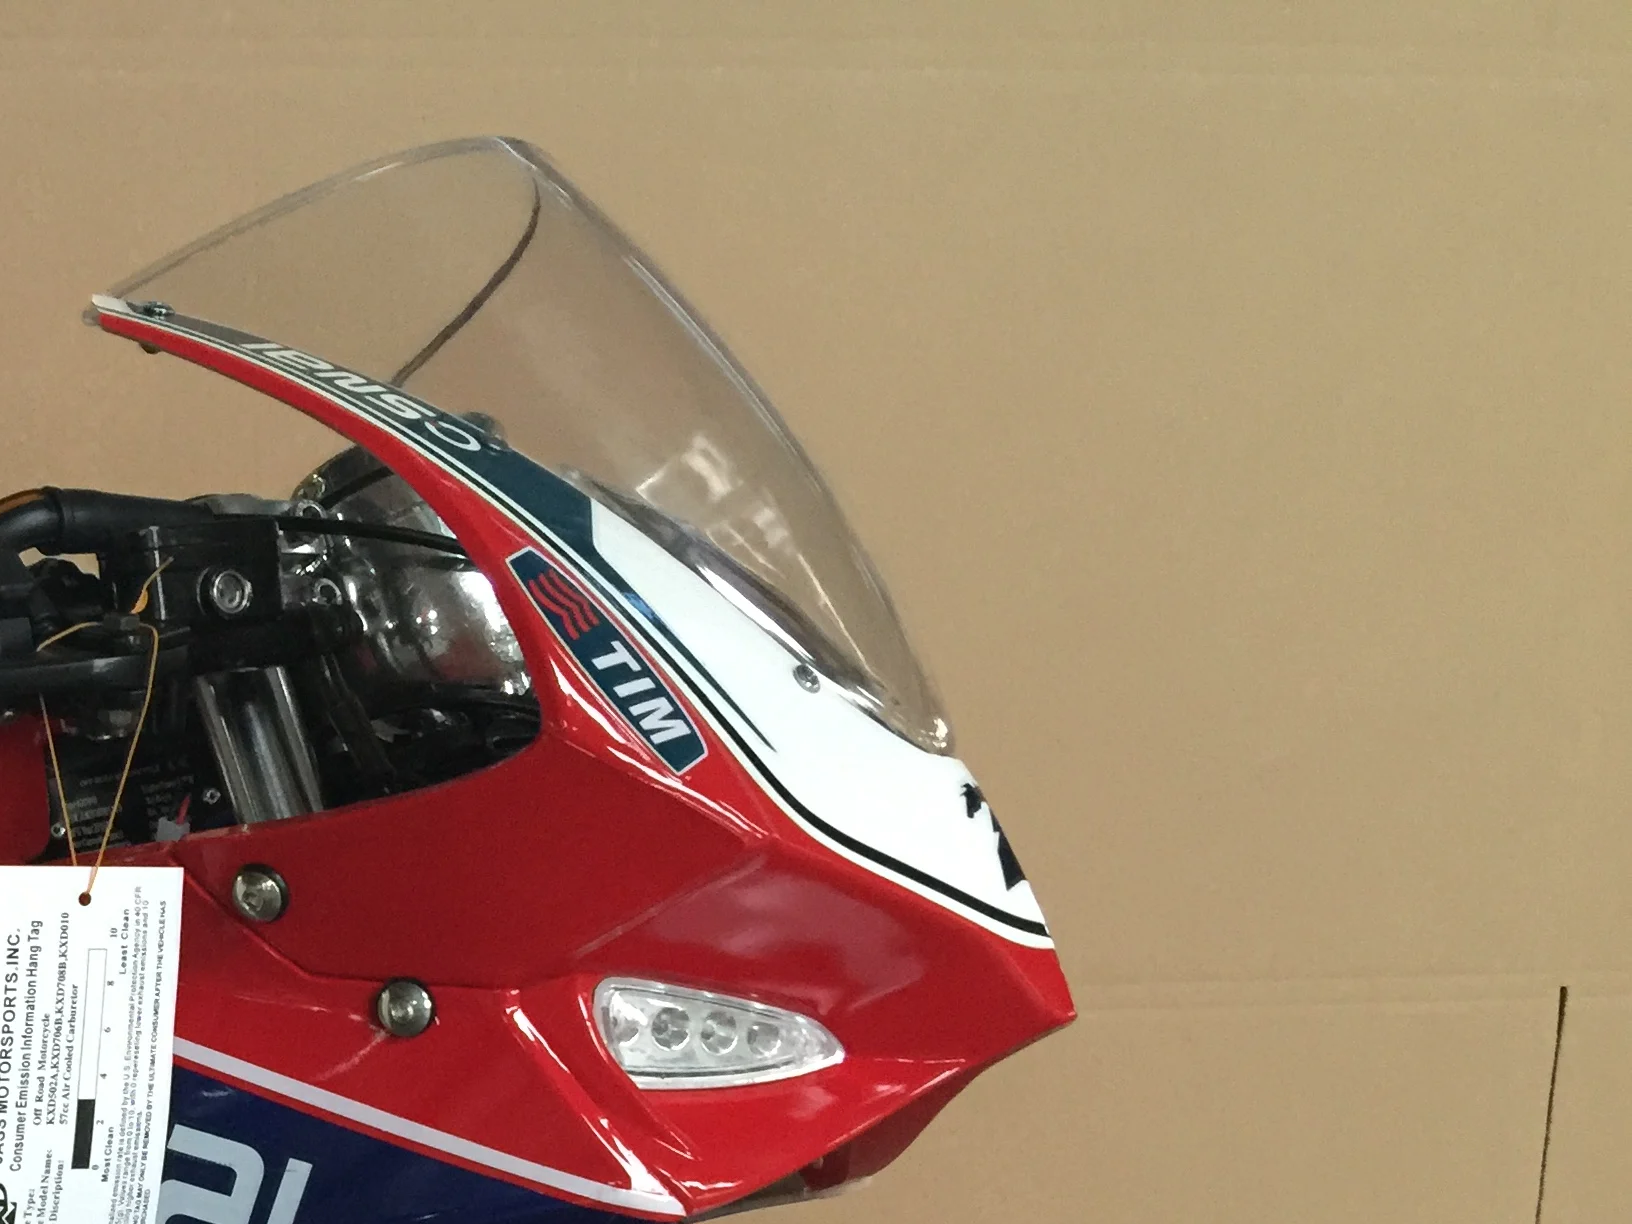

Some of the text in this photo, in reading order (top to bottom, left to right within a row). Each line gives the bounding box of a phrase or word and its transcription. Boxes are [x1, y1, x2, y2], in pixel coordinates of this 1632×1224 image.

[591, 641, 691, 745] TIM
[110, 927, 117, 937] 10
[66, 984, 78, 1043] Carburetor
[9, 920, 43, 1171] Consumer Emission Information Hang Tag
[37, 1013, 50, 1070] Motorcycle
[101, 909, 129, 1182] Most Clean Least Clean
[63, 1045, 73, 1080] Cooled
[35, 1076, 45, 1102] Road
[61, 1083, 70, 1099] Air
[33, 1108, 42, 1125] Off
[59, 1103, 69, 1124] 57cc
[36, 1185, 48, 1217] Model
